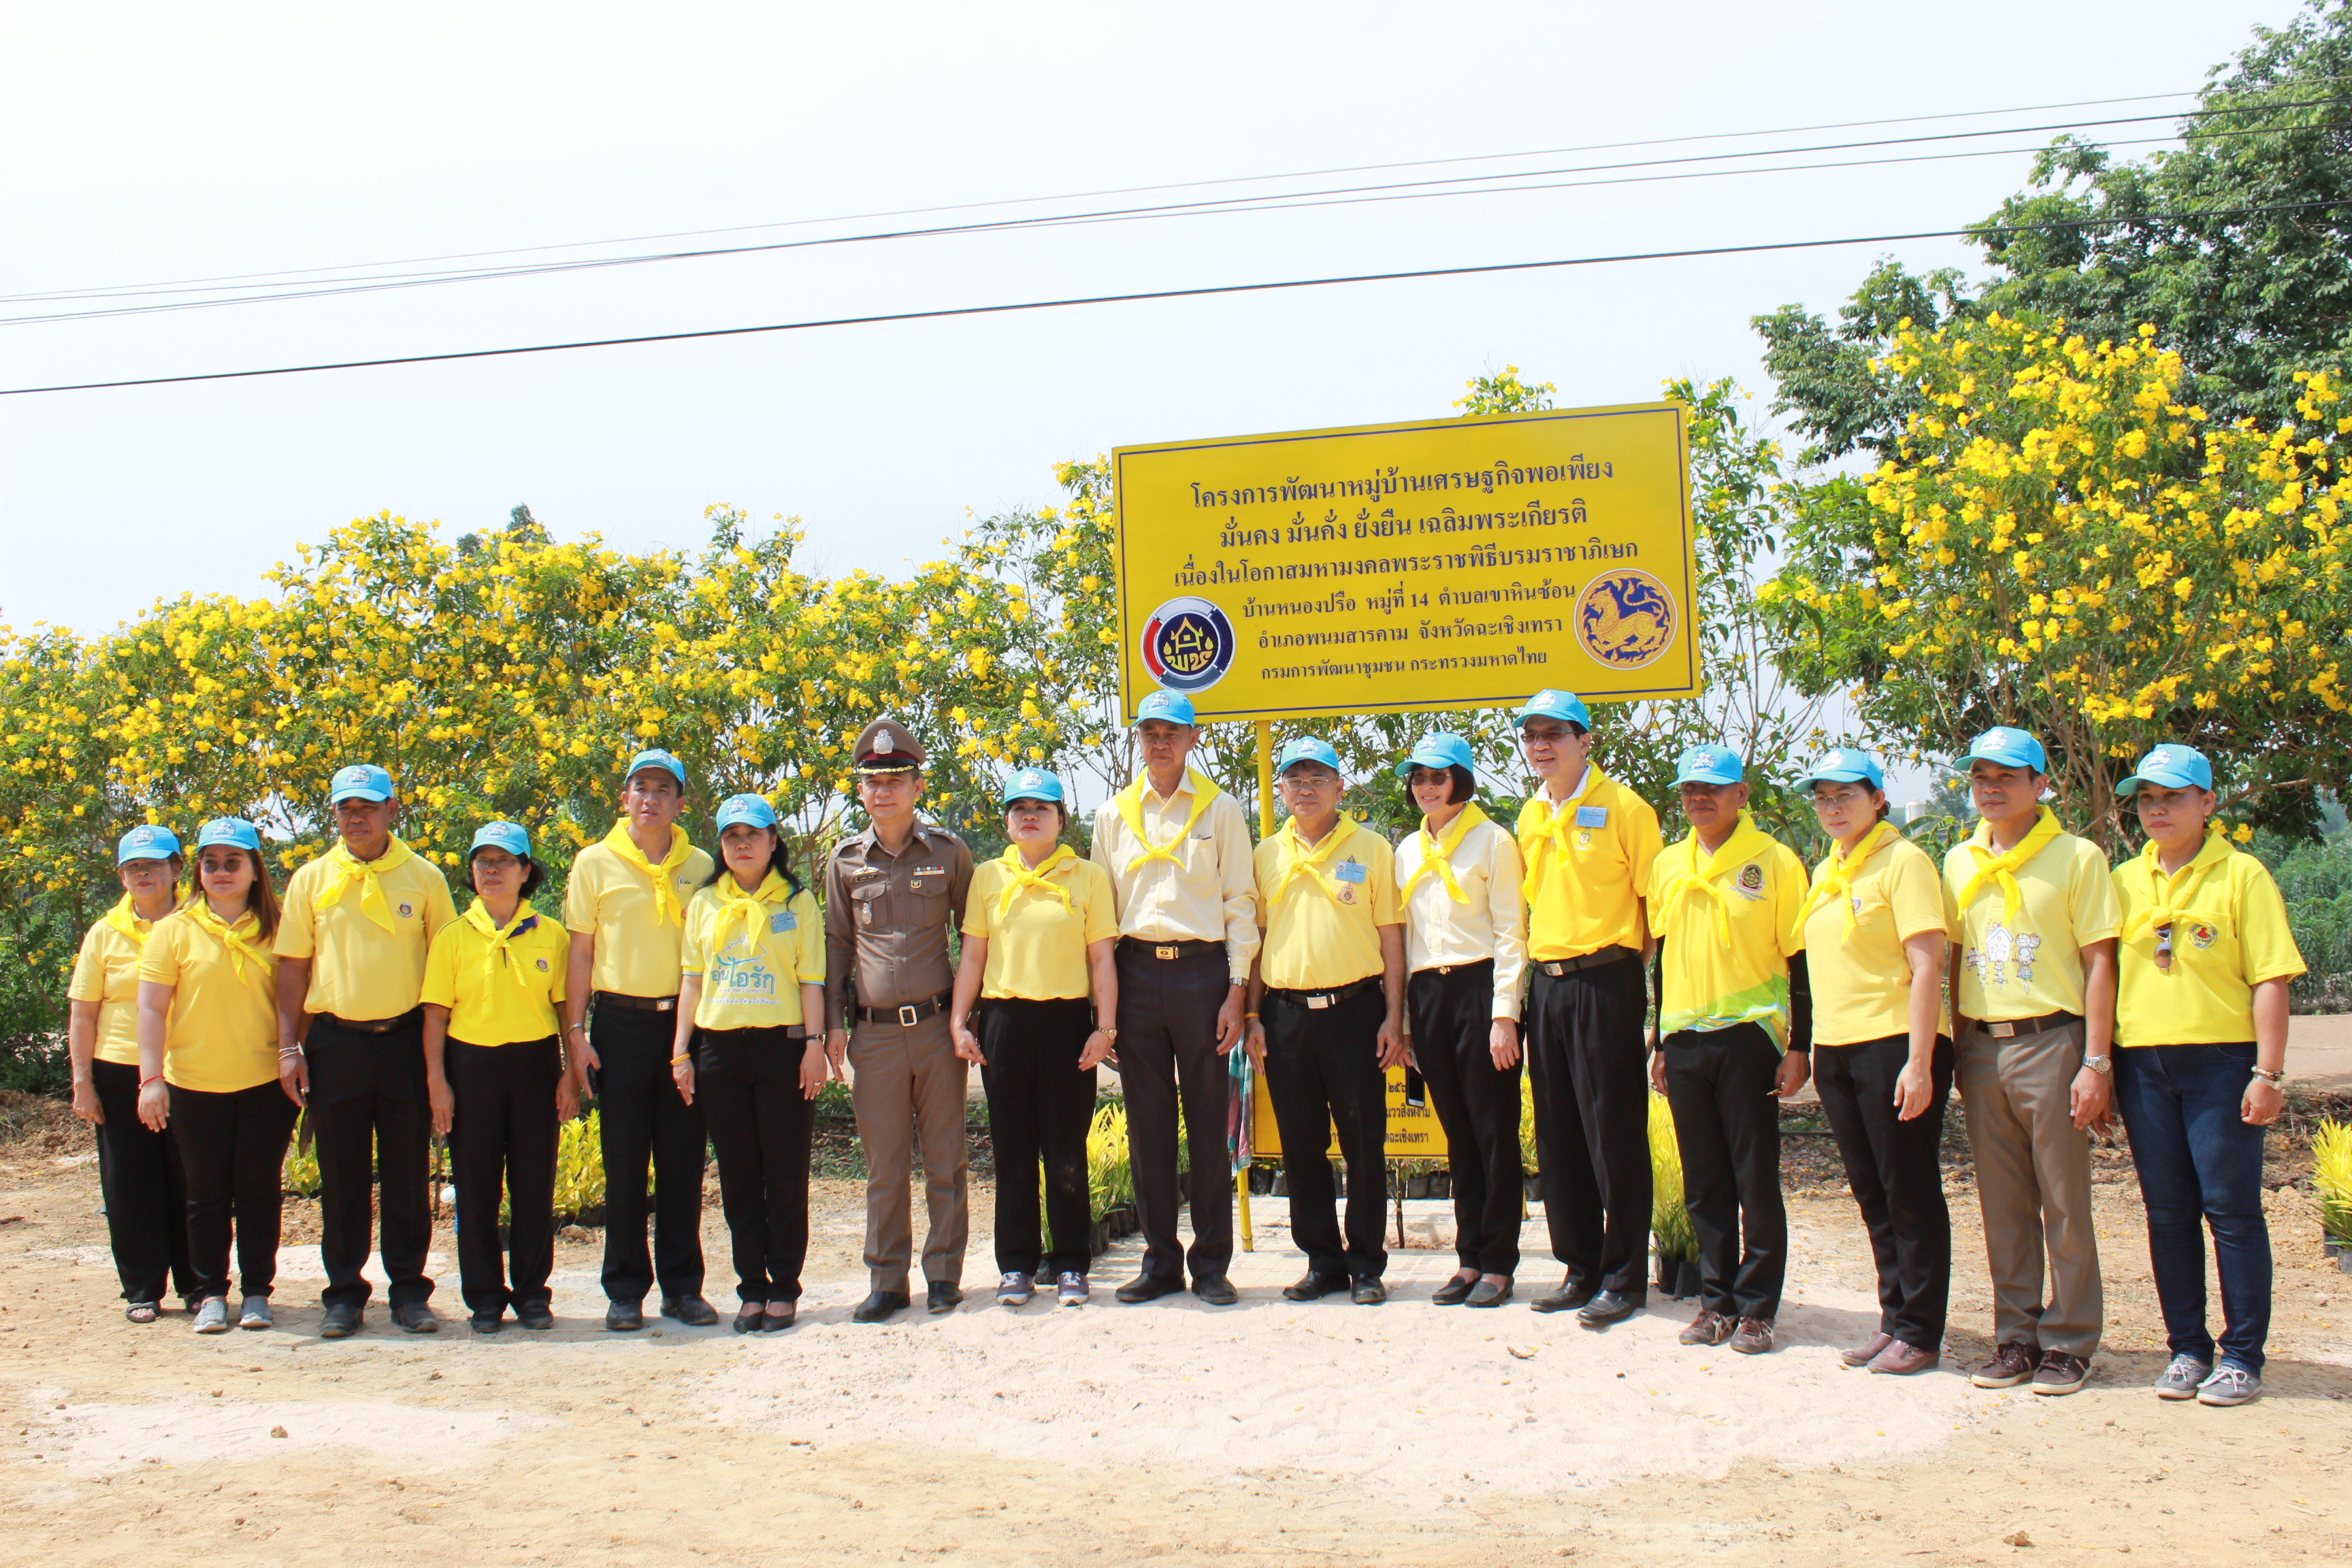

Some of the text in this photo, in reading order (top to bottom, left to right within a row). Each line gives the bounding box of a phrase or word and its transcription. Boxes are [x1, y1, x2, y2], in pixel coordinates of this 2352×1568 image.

[1190, 453, 1614, 508] โครงการพัฒนาหมู่บ้านเศรษฐกิจพอเพียง
[1220, 497, 1587, 548] มั่นคง มั่นคั่ง ยั่งยืน เฉลิมพระเกียรติ
[1175, 537, 1638, 587] เนื่องในโอกาสมหามงคลพระราชพิธีบรมราชาภิเษก
[1243, 578, 1576, 618] บ้านหนองปรือ หมู่ที่ 14 ตำบลเขาหินซ้อน
[1258, 615, 1563, 649] อำเภอพนมสารคาม จังหวัดฉะเชิงเทรา
[1262, 645, 1547, 680] กรมการพัฒนาชุมชน กระทรวงมหาดไทย
